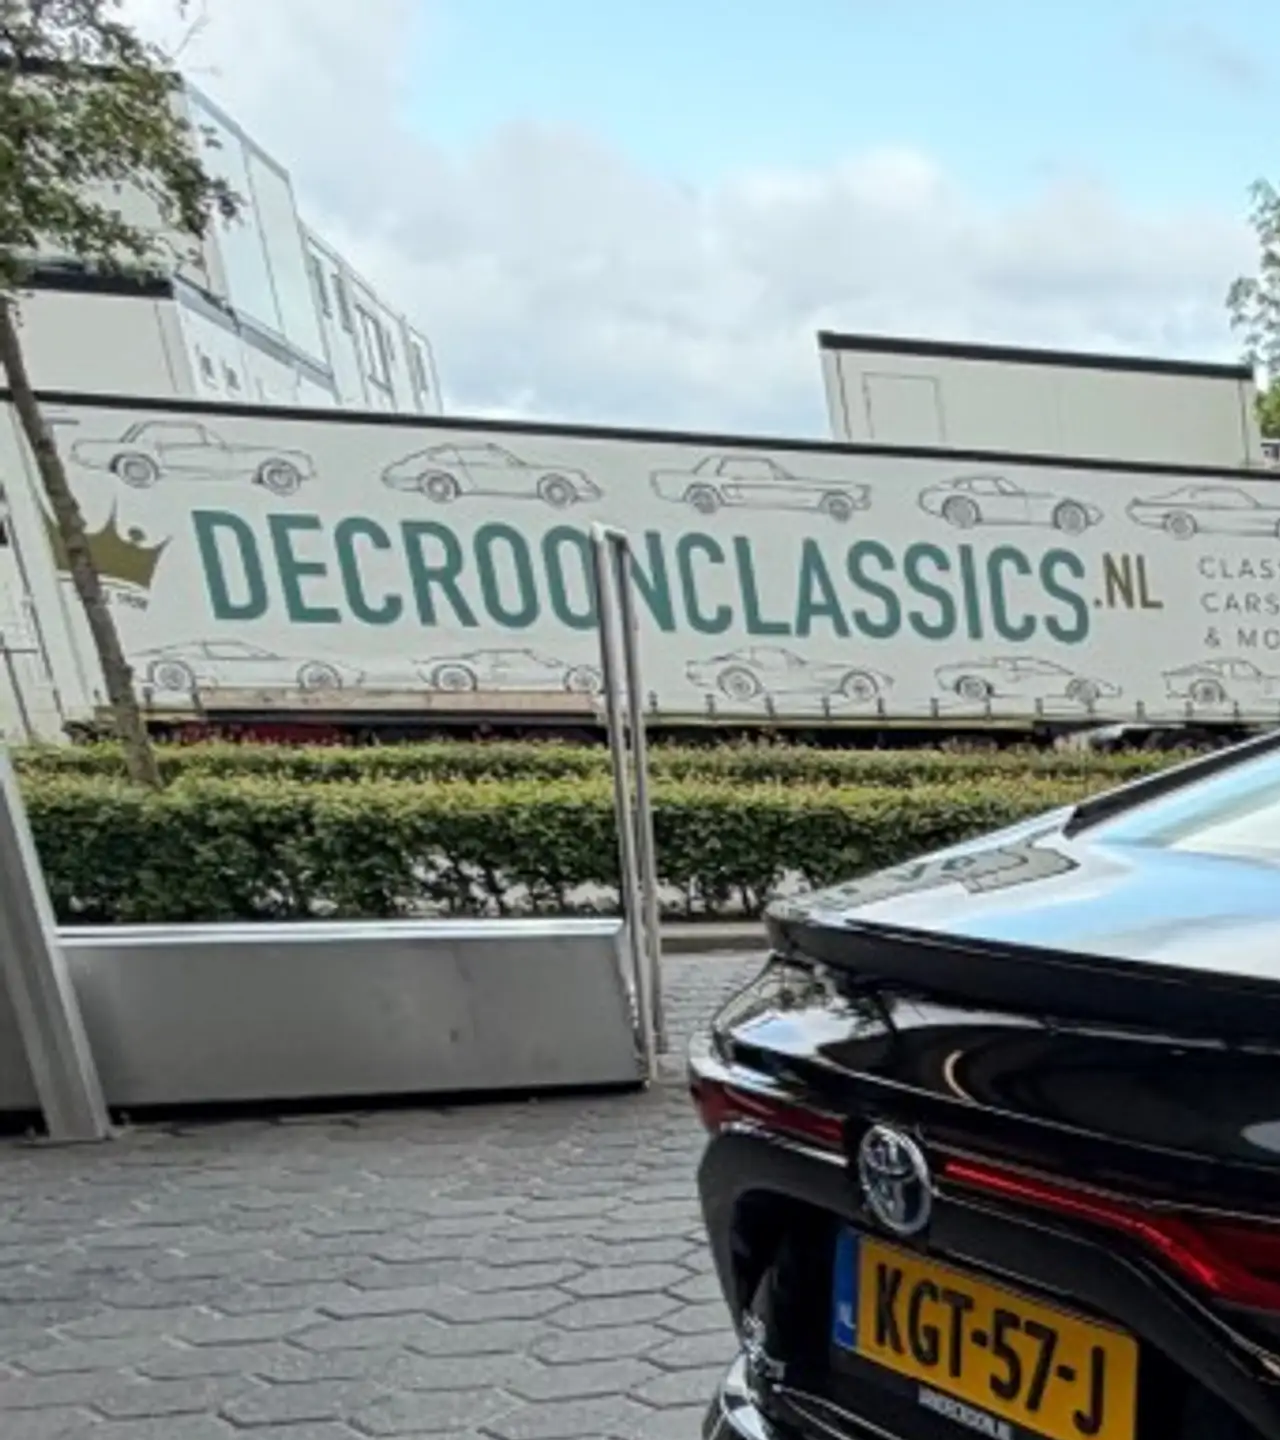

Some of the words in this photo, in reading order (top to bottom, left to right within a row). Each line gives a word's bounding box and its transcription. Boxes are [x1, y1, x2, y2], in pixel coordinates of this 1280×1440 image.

[1200, 591, 1280, 616] CARS
[1204, 627, 1221, 649] &
[874, 1262, 1106, 1437] KGT-57-J
